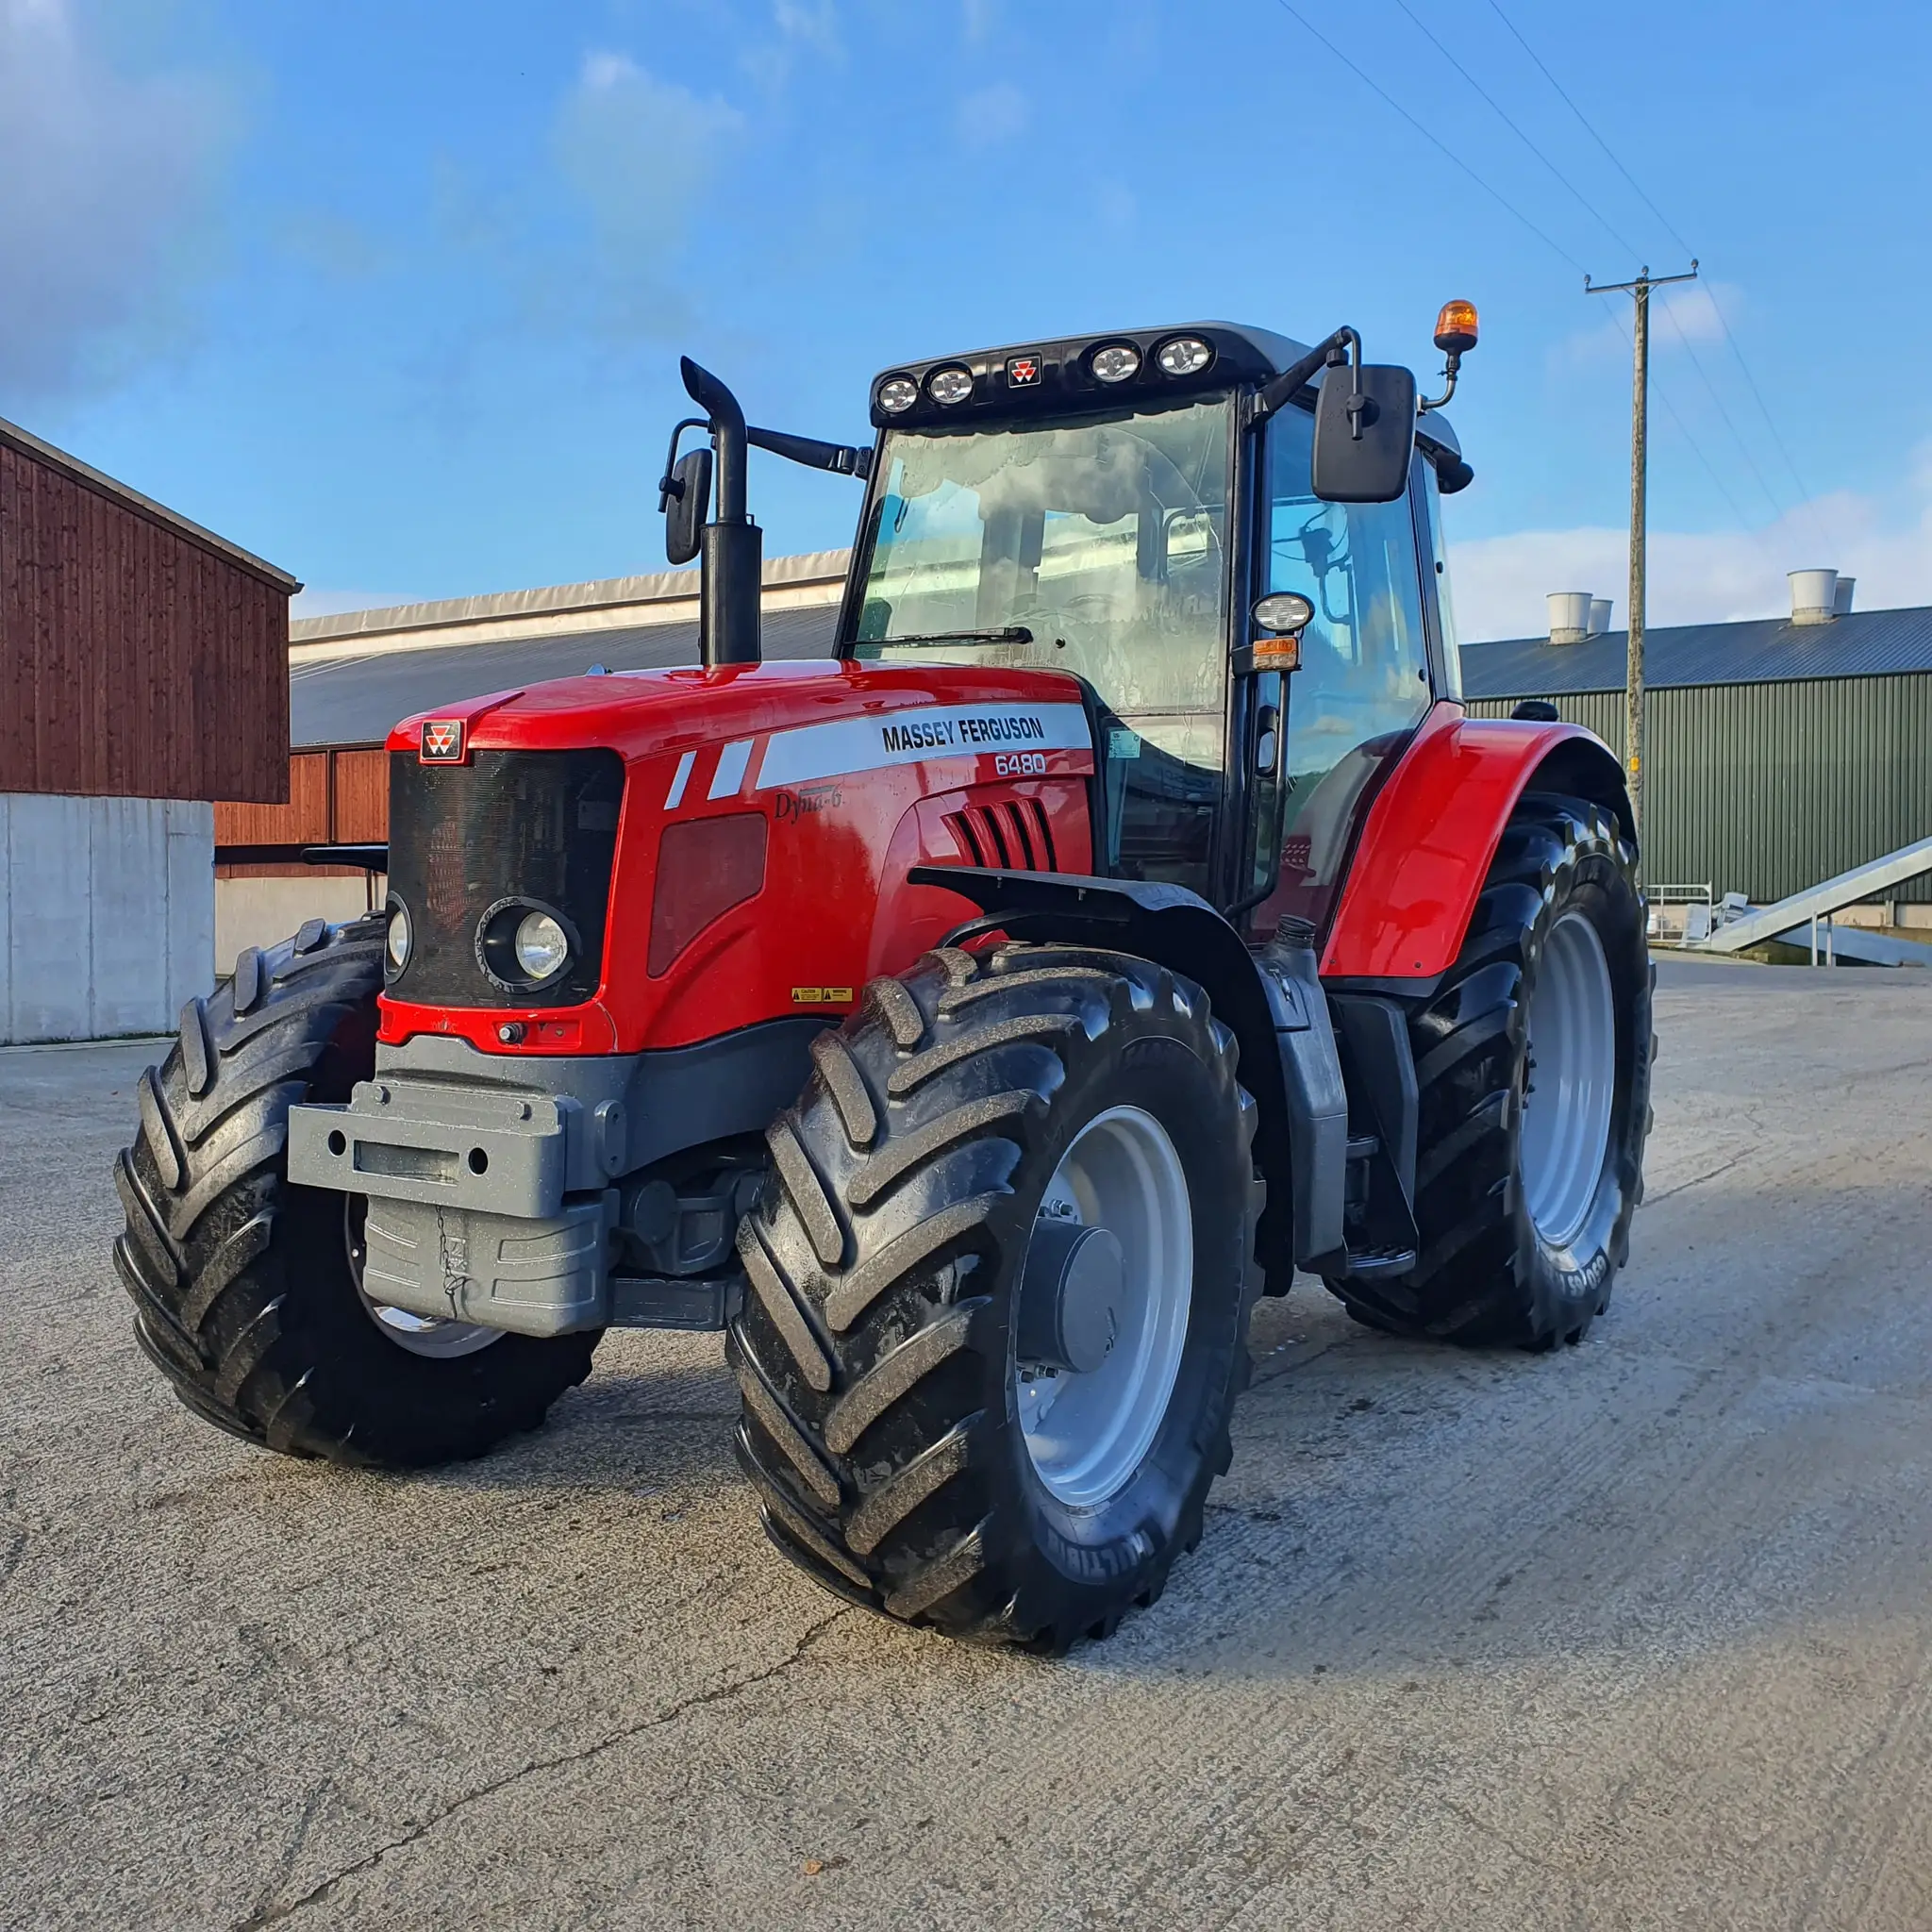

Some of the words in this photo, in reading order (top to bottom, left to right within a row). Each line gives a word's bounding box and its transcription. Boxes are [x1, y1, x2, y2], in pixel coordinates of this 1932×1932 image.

[882, 720, 954, 753] MASSEY
[958, 717, 1044, 743] FERGUSON
[995, 754, 1046, 775] 6480
[774, 785, 842, 825] Dyna-6
